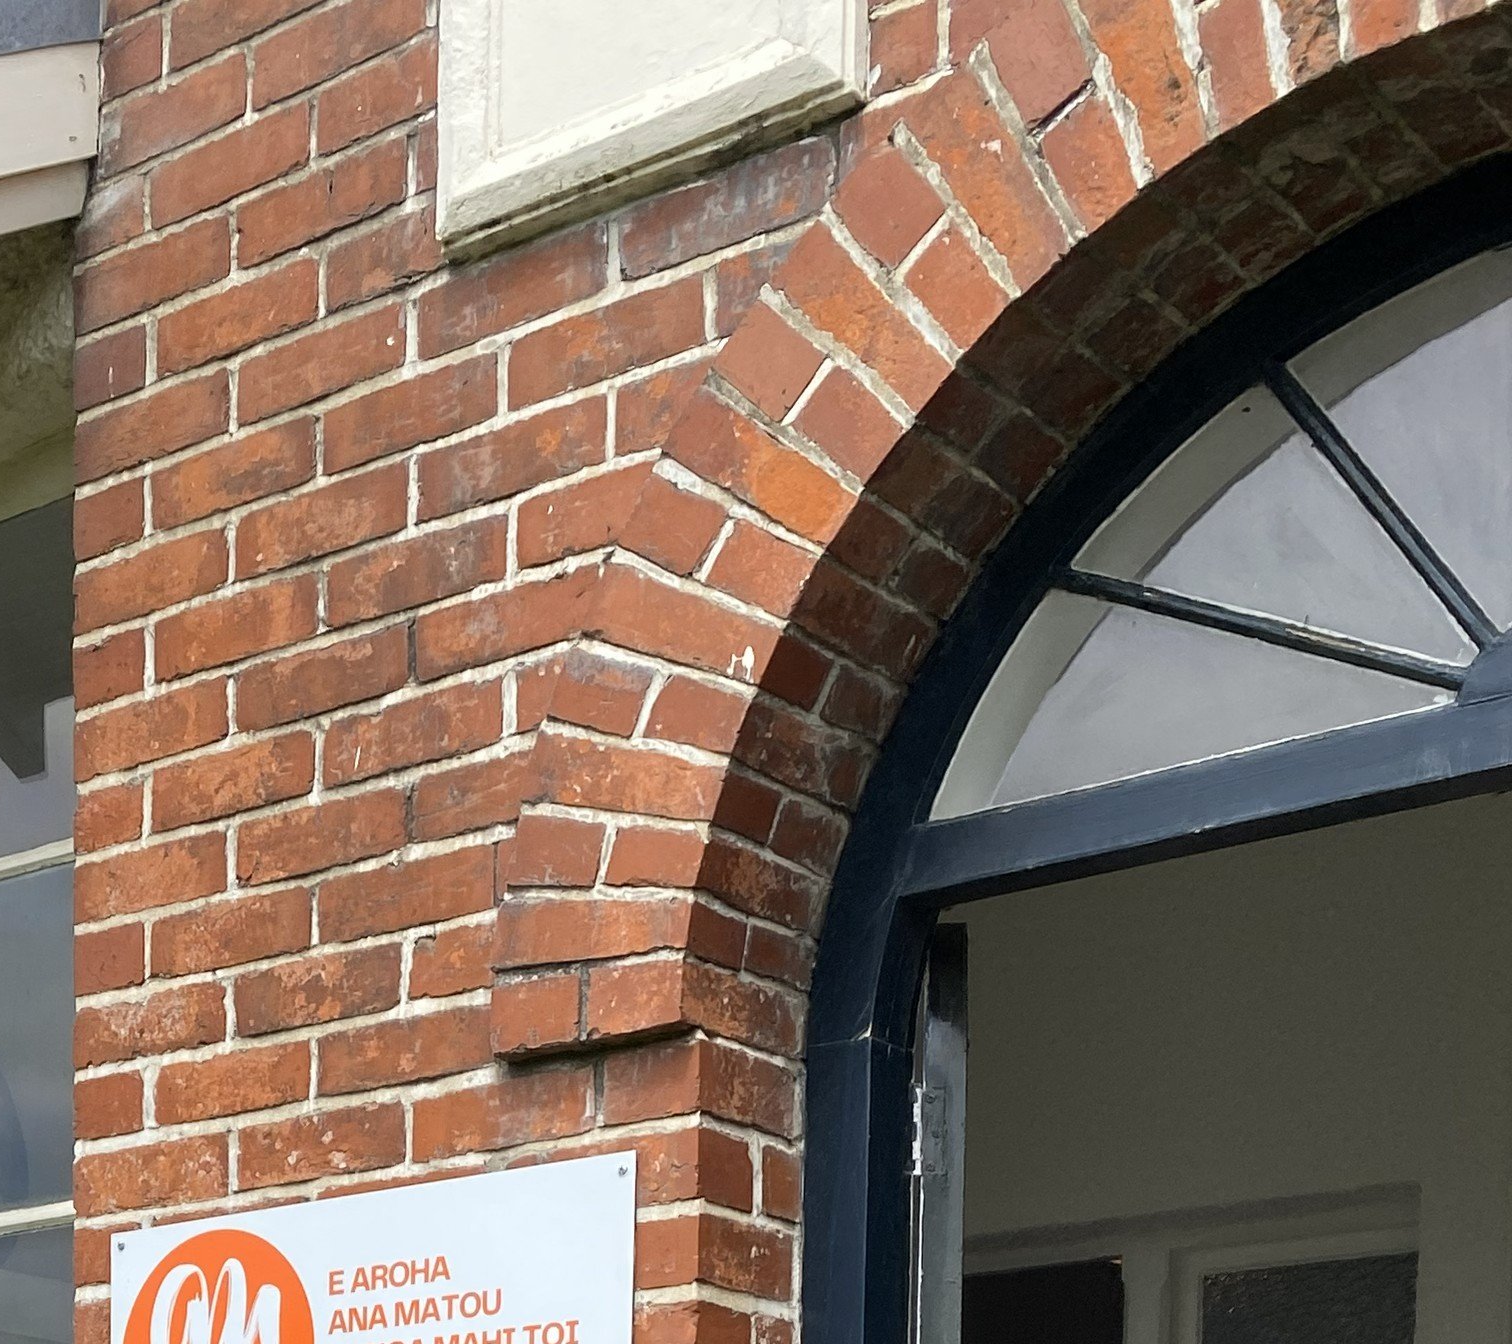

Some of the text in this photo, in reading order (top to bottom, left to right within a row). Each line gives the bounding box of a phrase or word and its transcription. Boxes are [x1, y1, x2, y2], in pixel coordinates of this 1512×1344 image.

[328, 1256, 451, 1296] E AROHA
[328, 1288, 502, 1335] ANA MATOU
